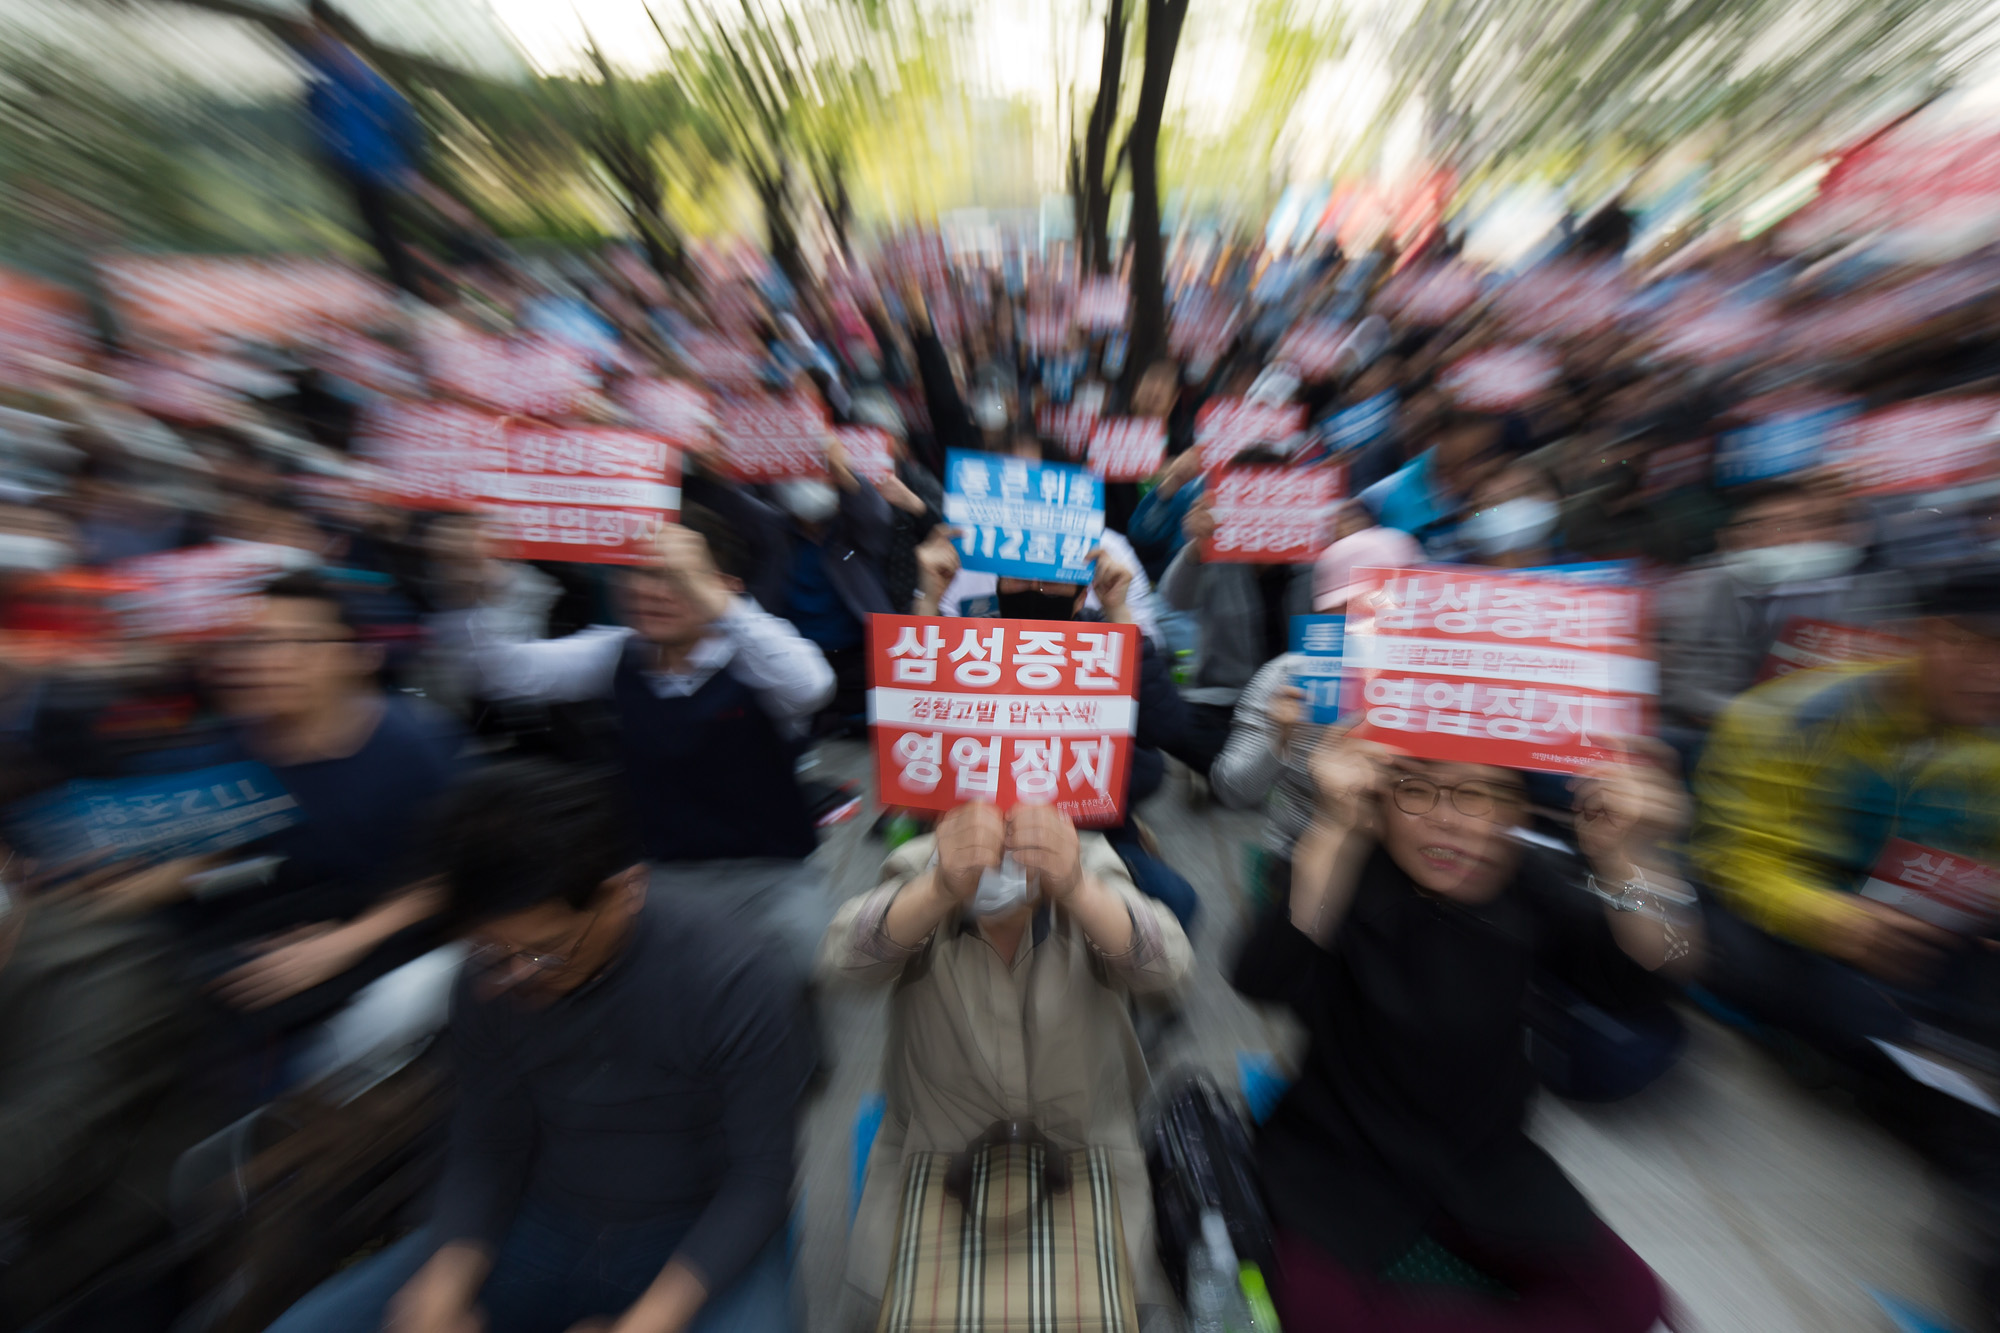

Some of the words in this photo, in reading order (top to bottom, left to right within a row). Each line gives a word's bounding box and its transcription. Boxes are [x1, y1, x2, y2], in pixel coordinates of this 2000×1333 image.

[1370, 579, 1602, 649] 삼성증권
[887, 625, 1124, 690] 삼성증권
[912, 696, 999, 723] 검찰고발
[1008, 700, 1097, 725] 압수수색!
[1364, 677, 1594, 748] 영업정지
[892, 732, 1116, 802] 영업정지
